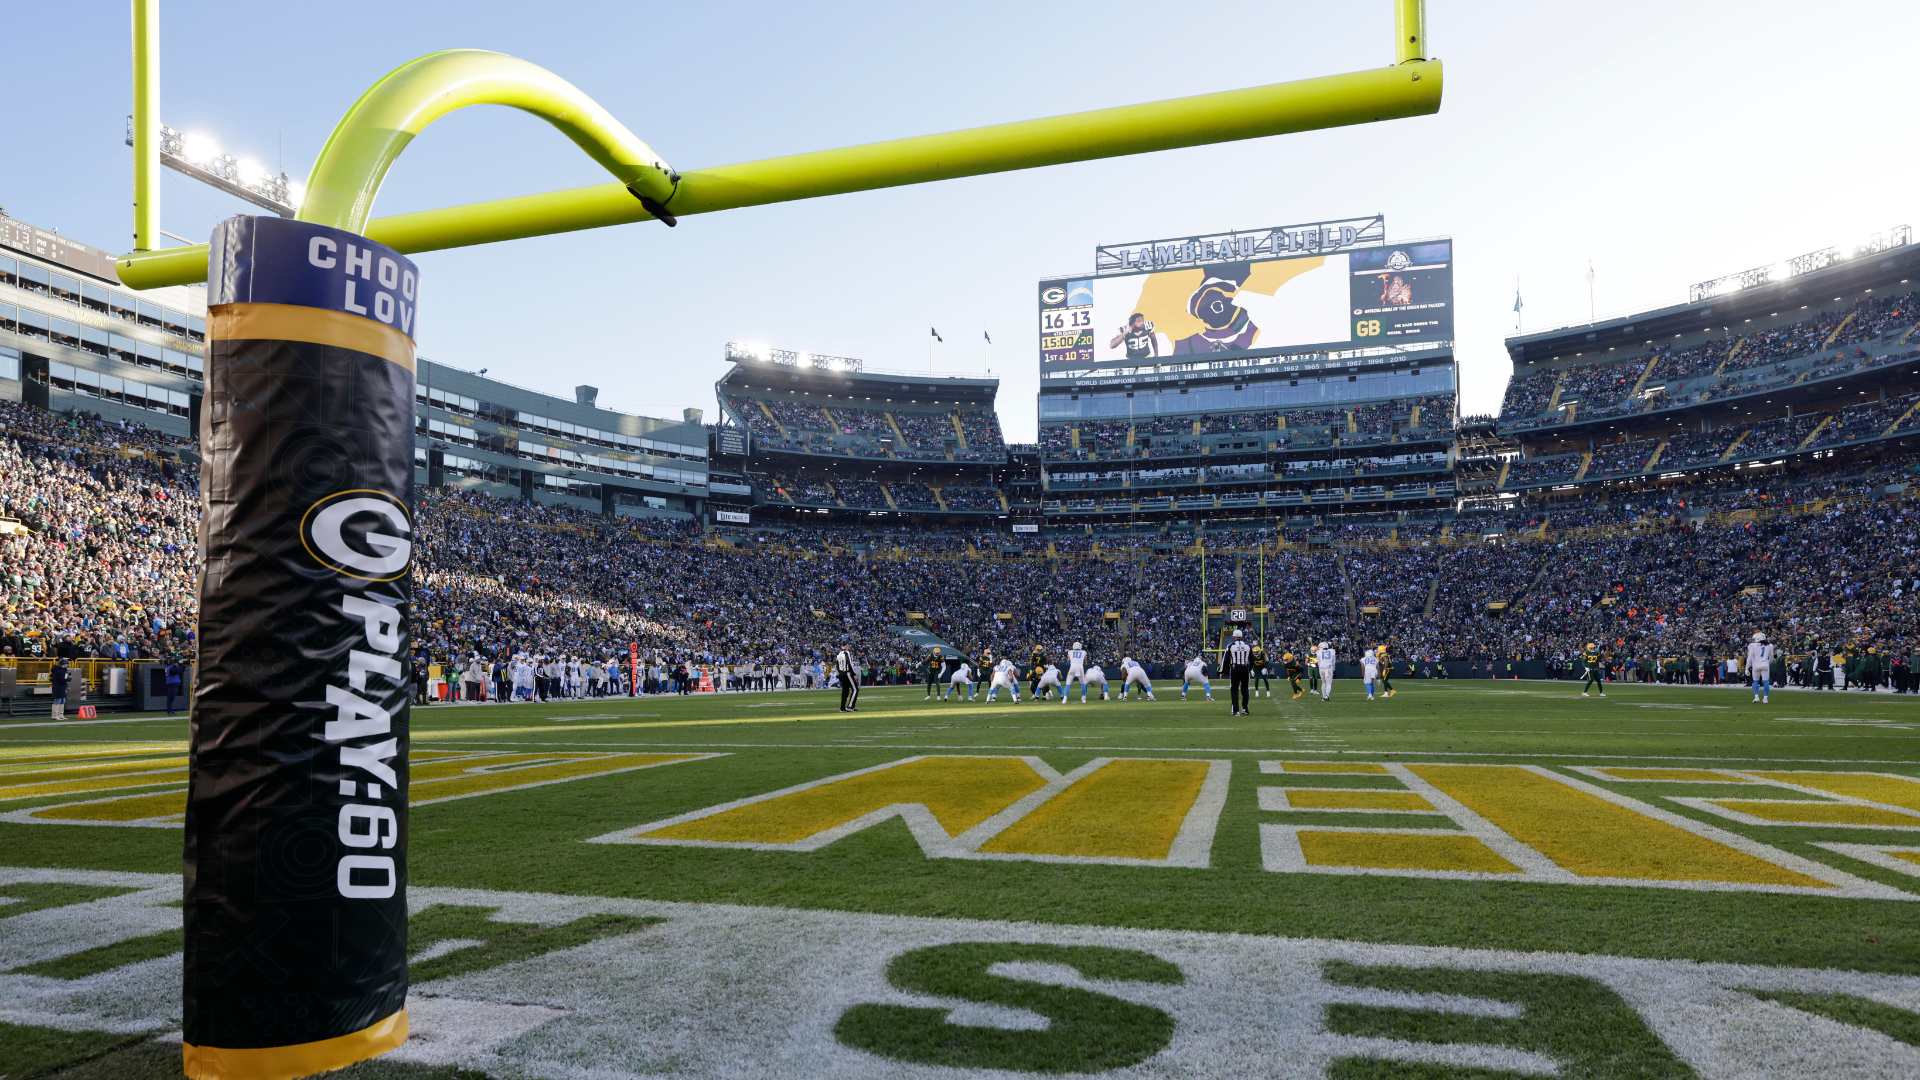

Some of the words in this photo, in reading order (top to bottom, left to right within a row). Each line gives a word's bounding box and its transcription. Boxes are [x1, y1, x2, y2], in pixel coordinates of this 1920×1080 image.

[1, 216, 32, 233] CHARGERS
[16, 229, 30, 244] 13
[36, 230, 57, 241] AROUND
[57, 237, 67, 245] THE
[67, 241, 86, 252] LEAGUE
[36, 238, 47, 247] PHI
[1120, 236, 1255, 269] LAMBEAU
[1270, 225, 1358, 253] FIELD
[36, 246, 45, 255] KC
[1045, 313, 1064, 329] 16
[1071, 310, 1091, 327] 13
[1356, 319, 1381, 337] GB
[1043, 336, 1074, 348] 15:00
[1078, 336, 1093, 345] :20
[1045, 353, 1058, 362] 1ST
[1065, 351, 1077, 360] 10
[1099, 377, 1136, 385] CHAMPIONS
[1389, 355, 1407, 363] 2010
[1233, 611, 1244, 619] 20
[31, 645, 42, 653] 93
[1760, 647, 1766, 658] 1
[1321, 651, 1331, 659] 13
[1587, 655, 1598, 663] 37
[1364, 657, 1376, 665] 82
[82, 706, 96, 718] 10
